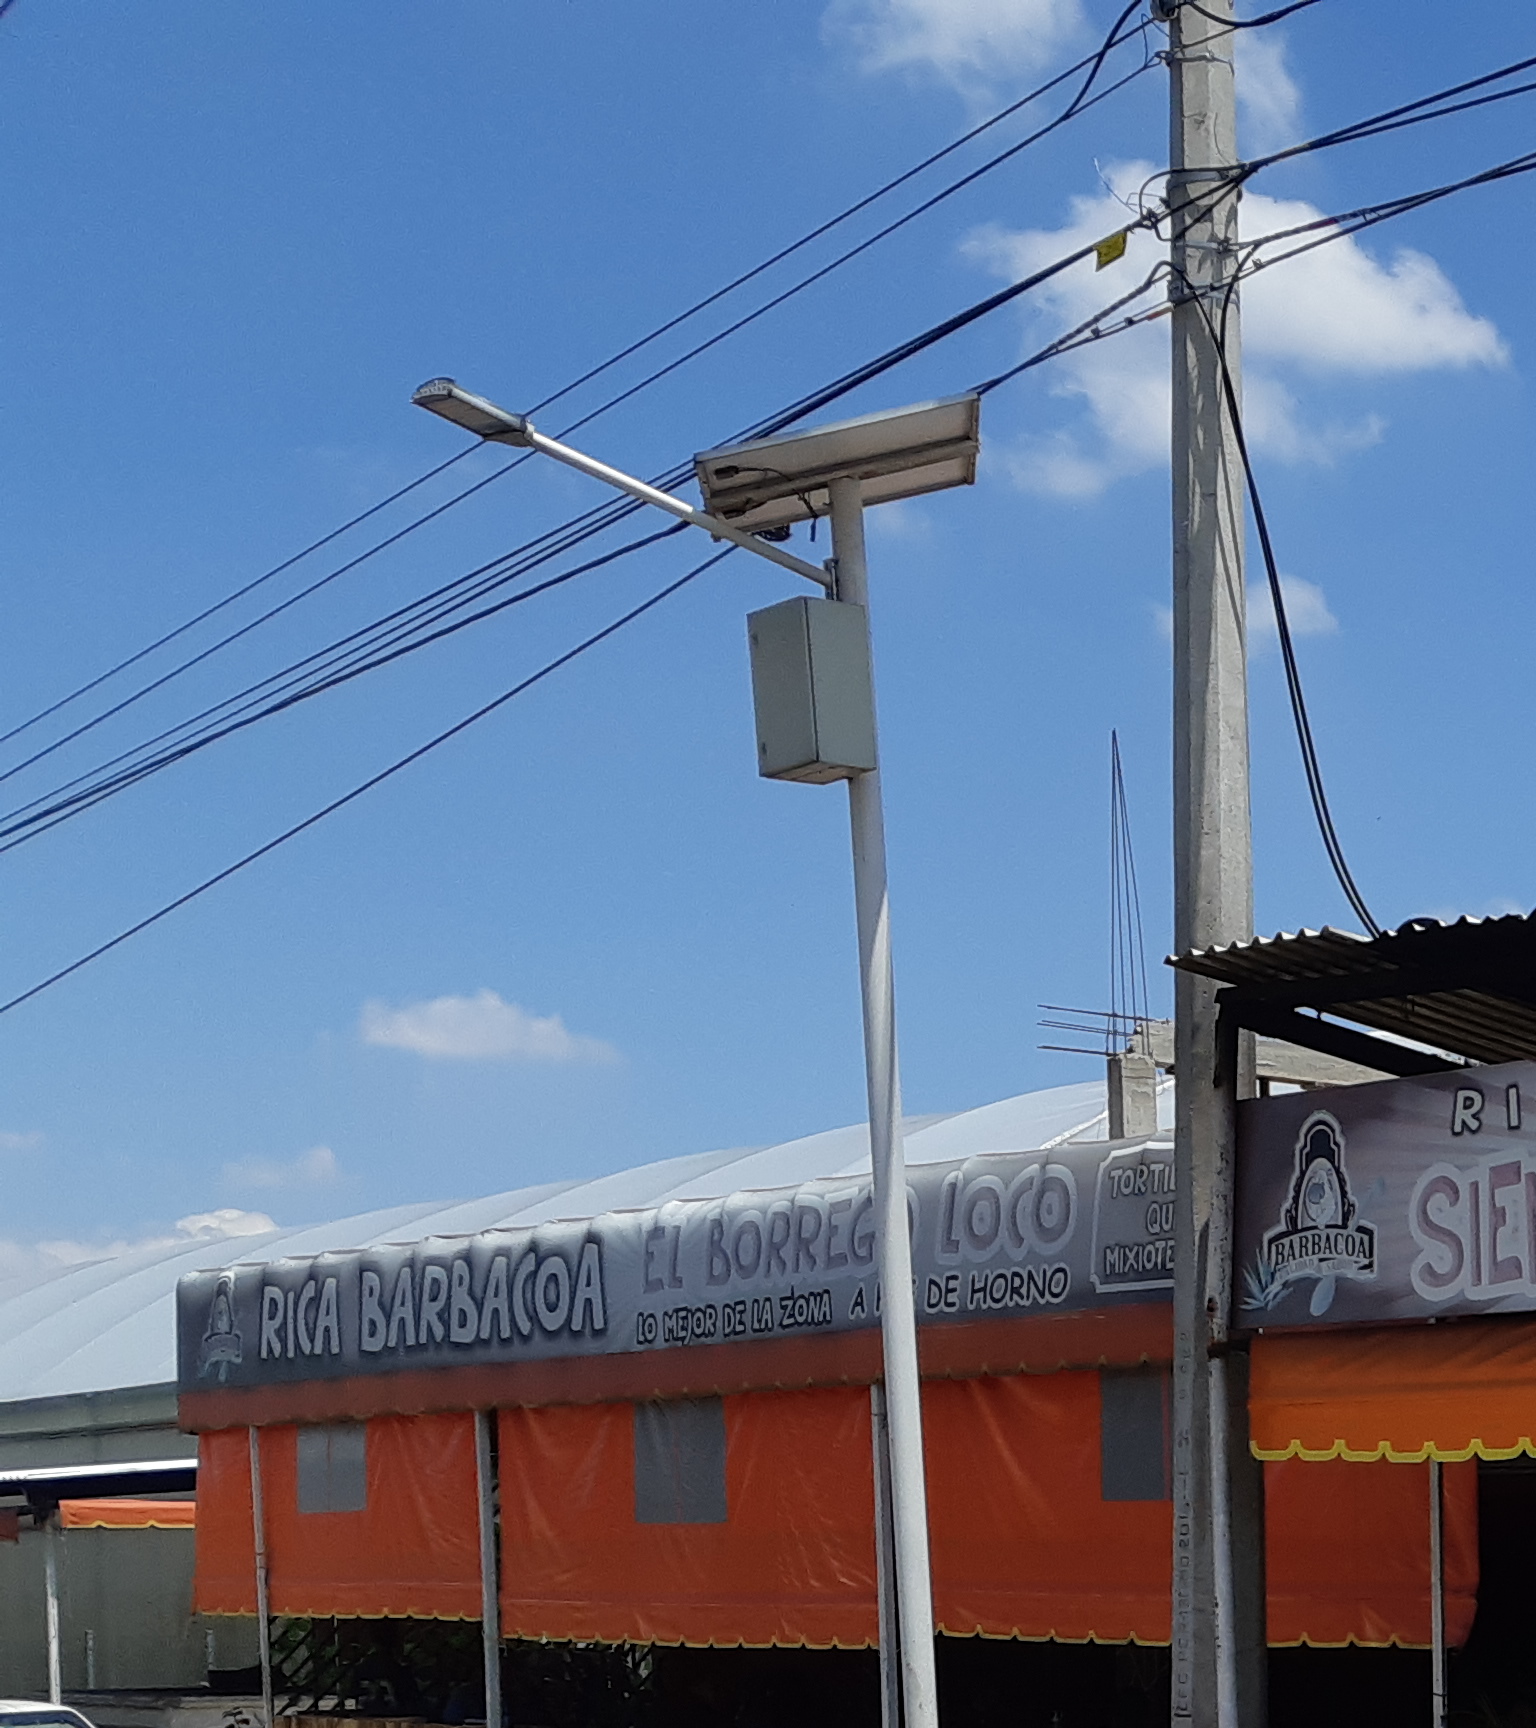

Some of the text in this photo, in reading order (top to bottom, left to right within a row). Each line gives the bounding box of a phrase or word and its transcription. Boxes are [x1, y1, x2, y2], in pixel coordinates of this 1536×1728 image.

[1109, 1162, 1177, 1199] TORTIL
[642, 1174, 1073, 1294] EL BORREG LOCO
[1274, 1232, 1370, 1267] BARBACOA
[1104, 1238, 1176, 1276] MIXIOTE
[259, 1240, 606, 1361] RICA BARBACOA
[926, 1274, 960, 1309] DE
[969, 1266, 1069, 1306] HORNO
[636, 1311, 658, 1345] LO
[663, 1302, 718, 1346] MEJOR
[722, 1298, 747, 1338] DE
[751, 1295, 774, 1333] LA
[779, 1286, 833, 1330] ZONA
[850, 1286, 867, 1316] A
